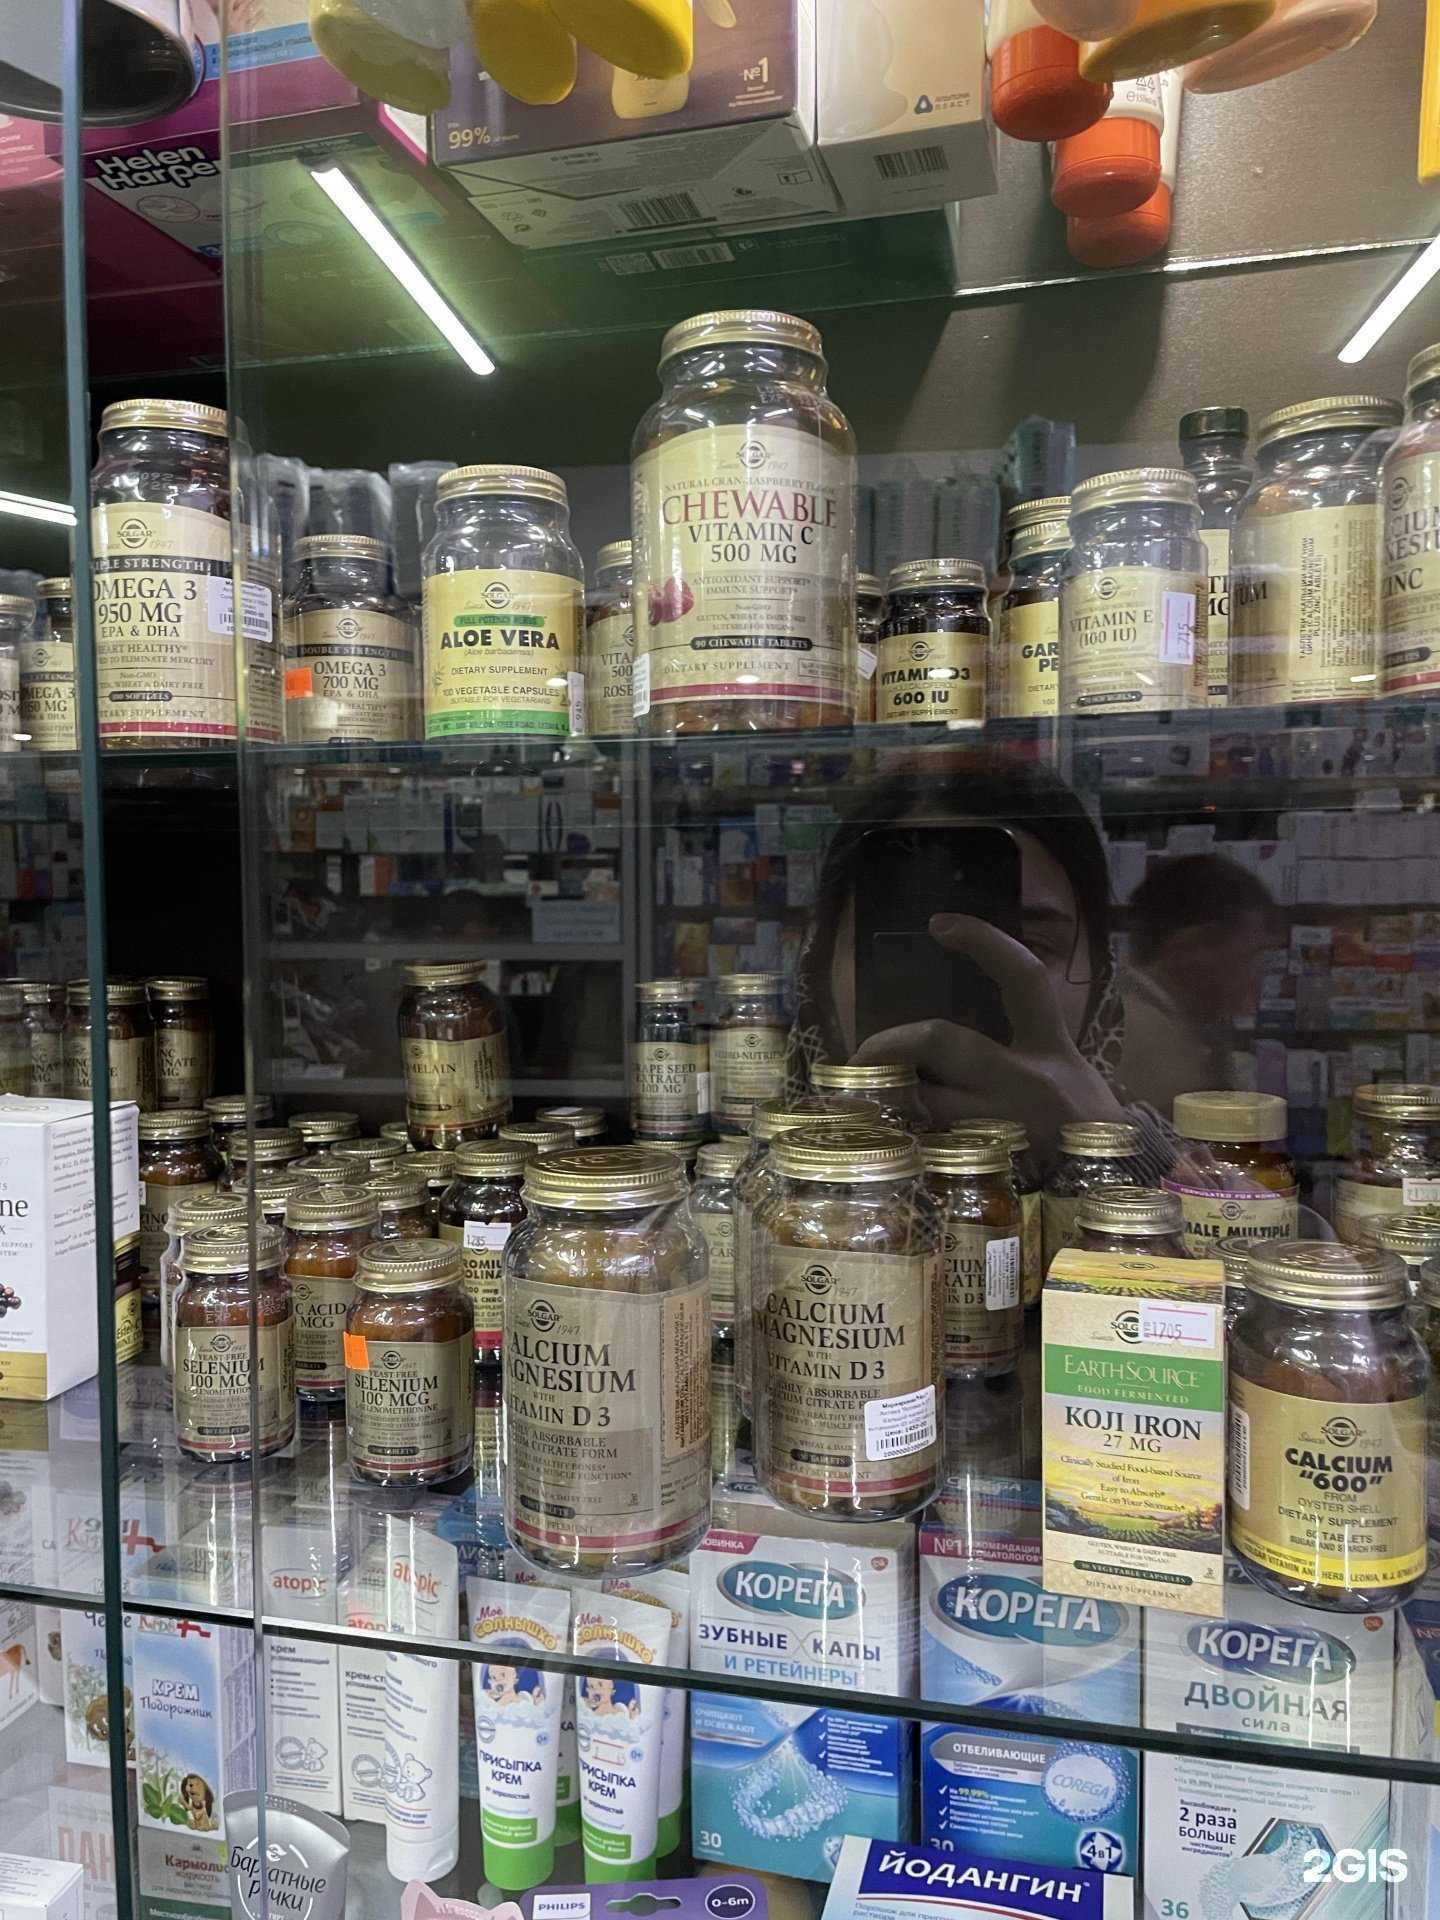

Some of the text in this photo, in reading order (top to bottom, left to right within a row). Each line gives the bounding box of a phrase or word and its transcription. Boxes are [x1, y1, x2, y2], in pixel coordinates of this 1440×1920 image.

[448, 126, 490, 150] 99%
[95, 146, 206, 175] Helen
[662, 490, 837, 528] CHEWABLE
[689, 523, 814, 545] VITAMIN C
[711, 544, 797, 564] 500 MG
[124, 558, 205, 572] STRENGTH
[184, 580, 197, 600] 3
[1385, 568, 1423, 597] INC
[99, 602, 182, 625] 950 MG
[1070, 609, 1153, 632] VITAMIN E
[102, 626, 180, 638] EPA & DHA
[441, 629, 560, 650] ALOE VERA
[708, 638, 765, 648] CHEWABLE
[766, 638, 808, 648] TABLETS
[1022, 643, 1058, 660] GAR
[314, 661, 386, 676] OMEGA 3
[601, 652, 633, 666] VITA
[712, 661, 791, 671] SUPPLEMENT
[451, 666, 548, 677] DIETARY SUPPLEMENT
[881, 668, 939, 687] VITAMI
[322, 676, 379, 690] 700 MG
[456, 686, 560, 697] VEGETABLE CAPSULES
[358, 690, 378, 698] DHA
[893, 690, 949, 706] 600 IU
[667, 1063, 697, 1074] SEED
[662, 1084, 682, 1094] MG
[1184, 1221, 1290, 1239] MALE MULTIPLE
[308, 1302, 347, 1316] ACID
[527, 1307, 561, 1323] SOLGAR
[766, 1292, 885, 1325] CALCIUM
[300, 1316, 336, 1329] MCG
[1111, 1319, 1138, 1332] SOLG
[509, 1331, 611, 1366] ALCIUM
[807, 1350, 832, 1361] WITH
[766, 1351, 841, 1380] VITAMIN
[190, 1374, 213, 1388] 100
[354, 1374, 439, 1392] SELENIUM
[508, 1358, 637, 1394] AGNESIUM
[361, 1390, 430, 1407] 100 MCG
[806, 1387, 881, 1400] ABSORBABLE
[1078, 1384, 1189, 1405] FOOD FERMENTED
[806, 1397, 856, 1410] CITRATE
[1066, 1406, 1202, 1441] KOJI IRON
[532, 1430, 608, 1448] ABSORBABLE
[1103, 1434, 1162, 1453] 27 MG
[581, 1448, 618, 1459] FORM
[1285, 1447, 1393, 1474] CALCIUM
[1095, 1460, 1126, 1472] Studied
[1297, 1497, 1381, 1514] OYSTER SHELL
[1323, 1491, 1357, 1501] FROM
[1278, 1505, 1398, 1528] DIETARY SUPPLEMENT
[933, 1537, 963, 1557] №1
[1321, 1531, 1373, 1544] TABLETS
[734, 1570, 845, 1609] КОРЕГА
[954, 1586, 1102, 1634] КОРЕГА
[473, 1615, 557, 1651] СОЛНЫШКО
[698, 1623, 881, 1662] ЗУБНЫЕ КАПЫ
[1197, 1626, 1332, 1671] КОРЕГА
[724, 1655, 858, 1686] И РЕТЕЙНЕРЫ
[152, 1678, 199, 1701] КРЕМ
[140, 1696, 213, 1719] Подорожник
[1184, 1681, 1348, 1723] ДВОЙНАЯ
[1241, 1716, 1291, 1733] сила
[479, 1750, 542, 1773] ПРИСЫПКА
[953, 1743, 1046, 1765] ОТБЕЛИВАЮЩИЕ
[491, 1770, 522, 1786] КРЕМ
[1051, 1772, 1110, 1799] COREGA
[588, 1779, 617, 1800] КРЕМ
[1179, 1806, 1237, 1829] 2 раза
[699, 1830, 722, 1849] 30
[1179, 1826, 1237, 1845] БОЛЬШЕ
[230, 1845, 327, 1894] Баратные
[878, 1849, 1082, 1903] ЙОДАНГИН
[248, 1880, 304, 1912] рчки
[537, 1900, 586, 1911] PHILIPS
[711, 1895, 750, 1908] 0-6m
[1161, 1899, 1190, 1919] 36
